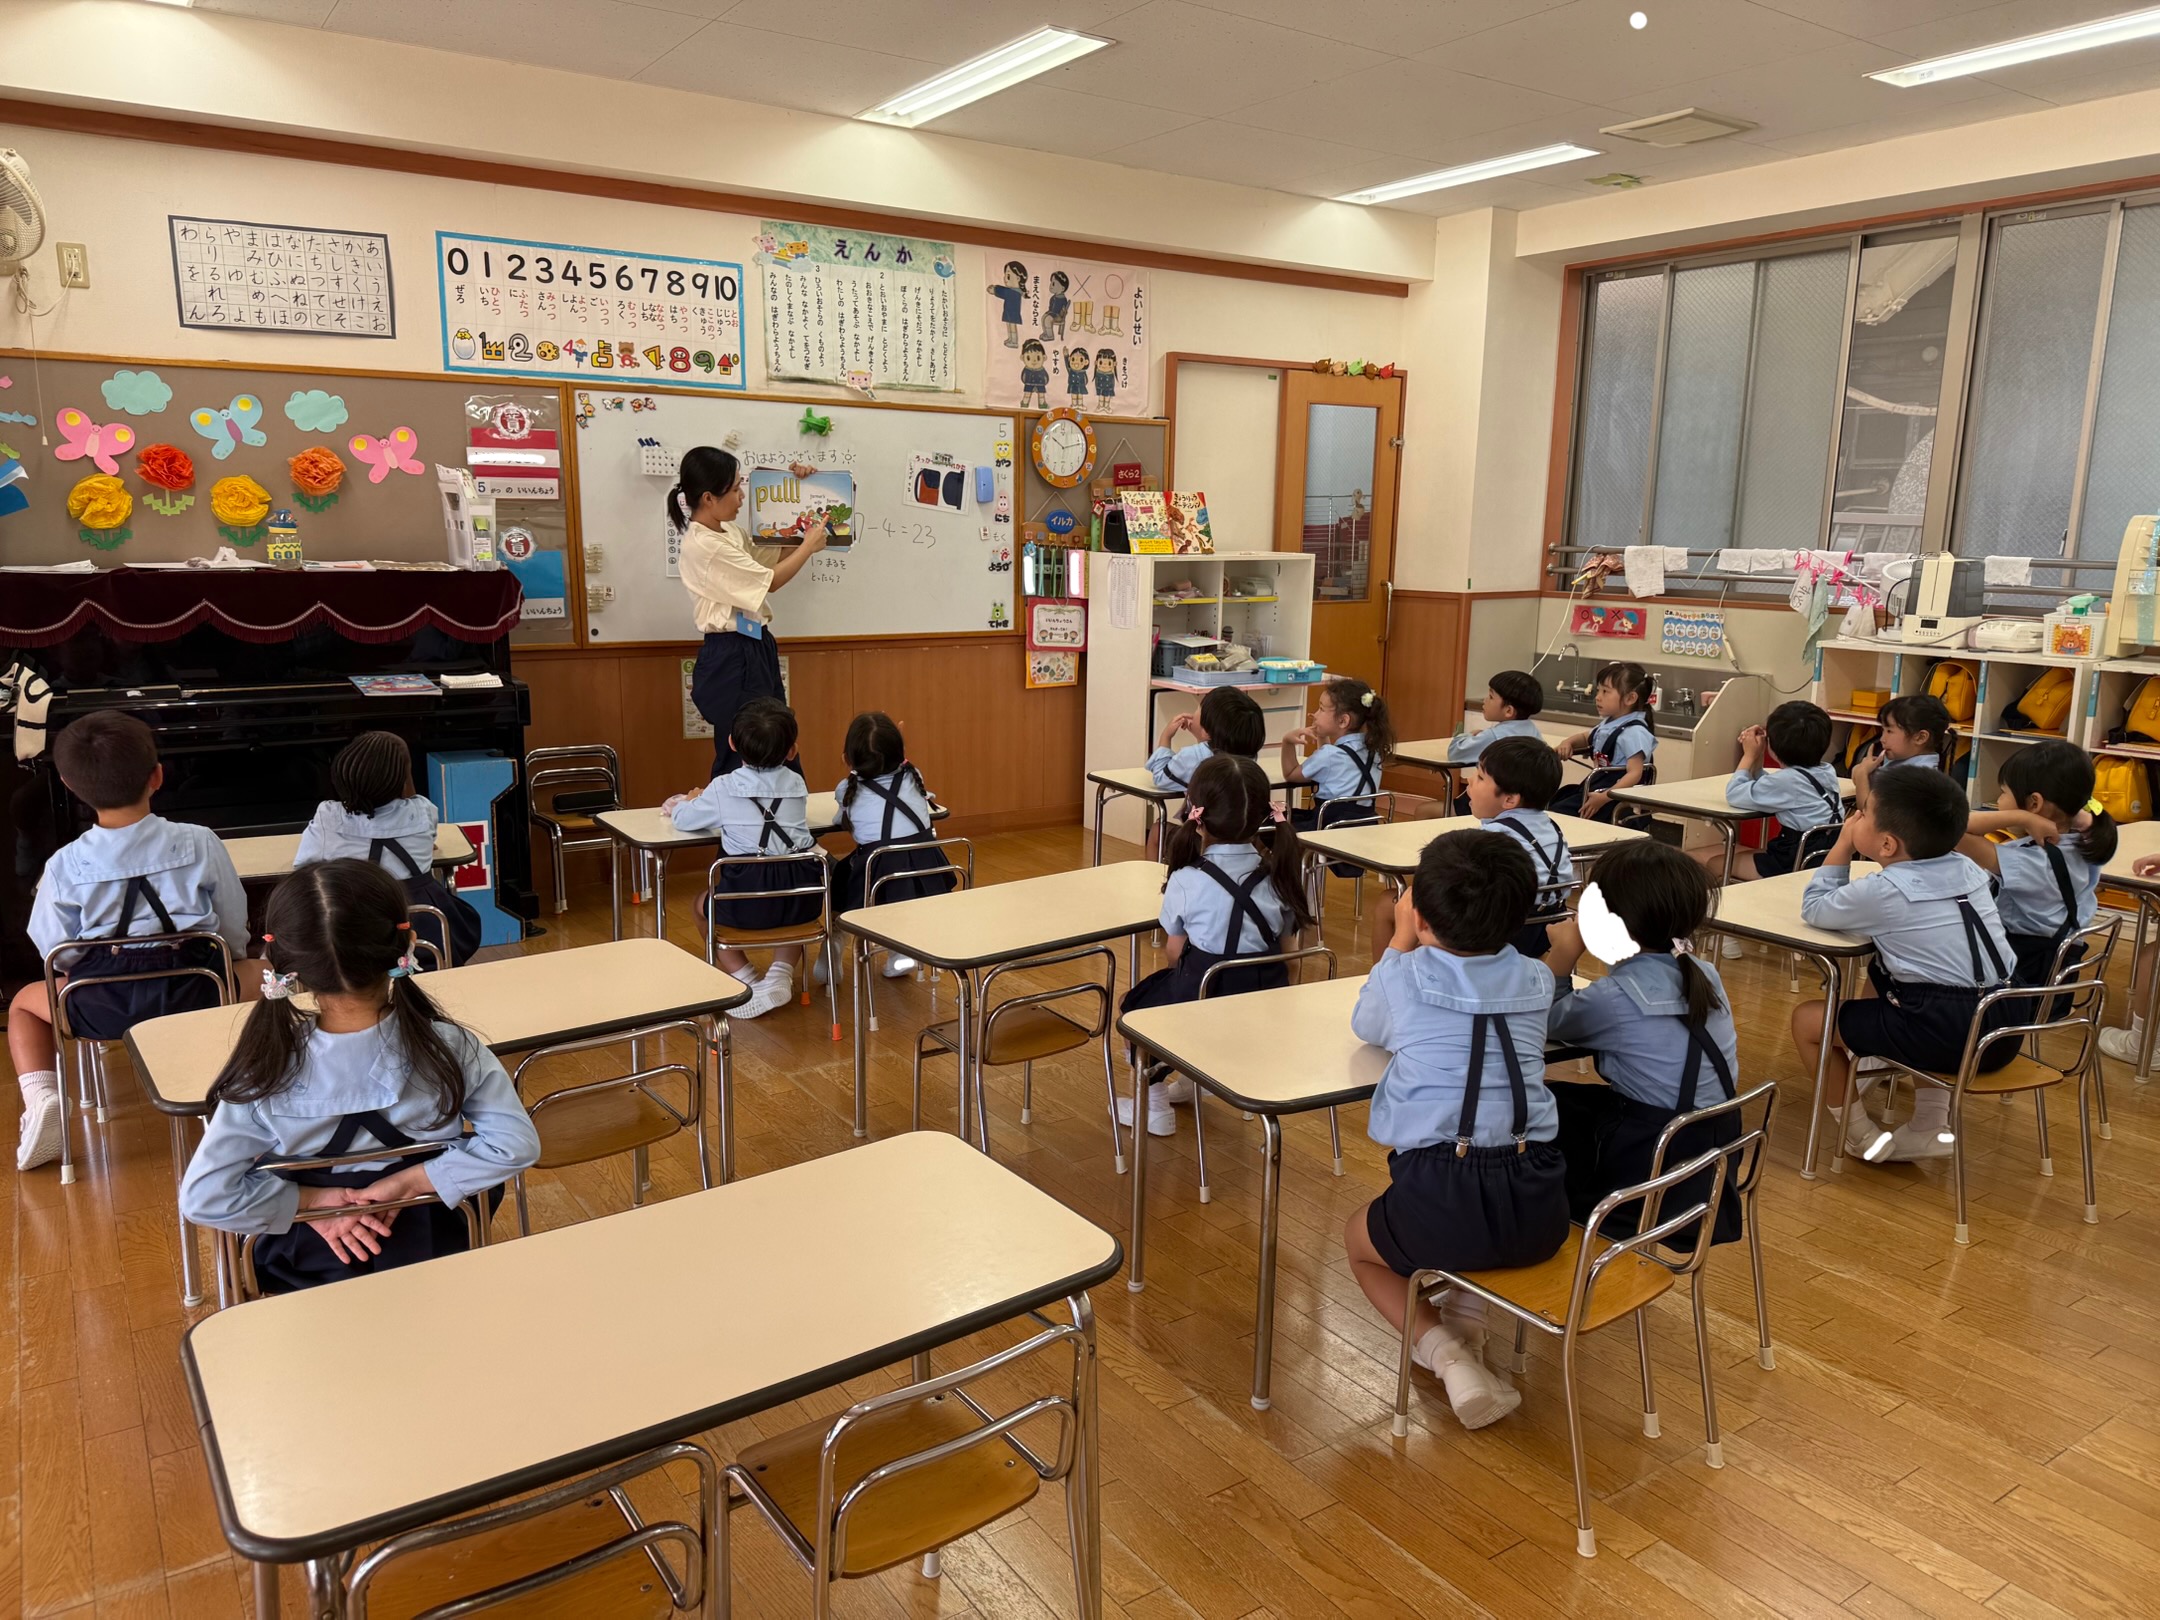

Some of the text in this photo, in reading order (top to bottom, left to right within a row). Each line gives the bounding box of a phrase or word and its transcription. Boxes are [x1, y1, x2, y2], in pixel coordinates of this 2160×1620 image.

[834, 239, 913, 265] えんか
[447, 248, 737, 301] 0 1 2 3 4 5 6 7 8 9 10
[815, 265, 820, 273] 3
[455, 284, 465, 304] ぜろ
[479, 286, 489, 306] いち
[491, 287, 501, 315] ひとつ
[509, 289, 518, 298] に
[519, 290, 529, 318] ふたつ
[537, 292, 546, 311] さん
[562, 294, 568, 303] し
[569, 294, 578, 314] よん
[590, 297, 598, 307] ご
[815, 277, 823, 326] ひろいおそらの
[851, 280, 860, 329] うたってあそぶ
[900, 285, 909, 313] ぼくらの
[1032, 275, 1040, 326] まえへならえ
[546, 292, 557, 321] みっつ
[578, 295, 587, 323] よっつ
[600, 298, 610, 325] いつつ
[617, 301, 625, 319] ろく
[627, 301, 637, 328] むっつ
[641, 302, 649, 321] しち
[648, 303, 657, 322] なな
[656, 304, 665, 331] ななつ
[670, 305, 678, 324] はち
[692, 307, 698, 316] く
[724, 309, 731, 326] じっ
[785, 274, 796, 359] たのしくまなぶ なかよし
[879, 283, 887, 333] とおいおやまに
[914, 286, 923, 335] げんきにそだつ
[1133, 287, 1143, 345] よいしせい
[679, 306, 688, 333] やっつ
[699, 307, 707, 335] きゅう
[707, 308, 715, 340] ここのつ
[716, 308, 724, 336] じゅう
[731, 310, 739, 328] とお
[770, 272, 782, 373] みんなの はぎわらようちえん
[800, 275, 811, 370] みんな なかよく てをつなぎ
[836, 279, 847, 378] わたしの はぎわらようちえん
[1052, 350, 1060, 375] やすめ
[999, 423, 1007, 438] 5
[742, 450, 837, 466] おはようございます
[995, 459, 1011, 468] がつ
[1118, 469, 1140, 479] さくら2
[477, 481, 486, 493] 5
[755, 477, 801, 512] pull!
[995, 513, 1010, 523] にち
[1051, 517, 1073, 527] イルカ
[993, 533, 1006, 541] もく
[988, 561, 1012, 572] ようび
[526, 607, 562, 615] いいんちょう
[988, 620, 1009, 628] てんき
